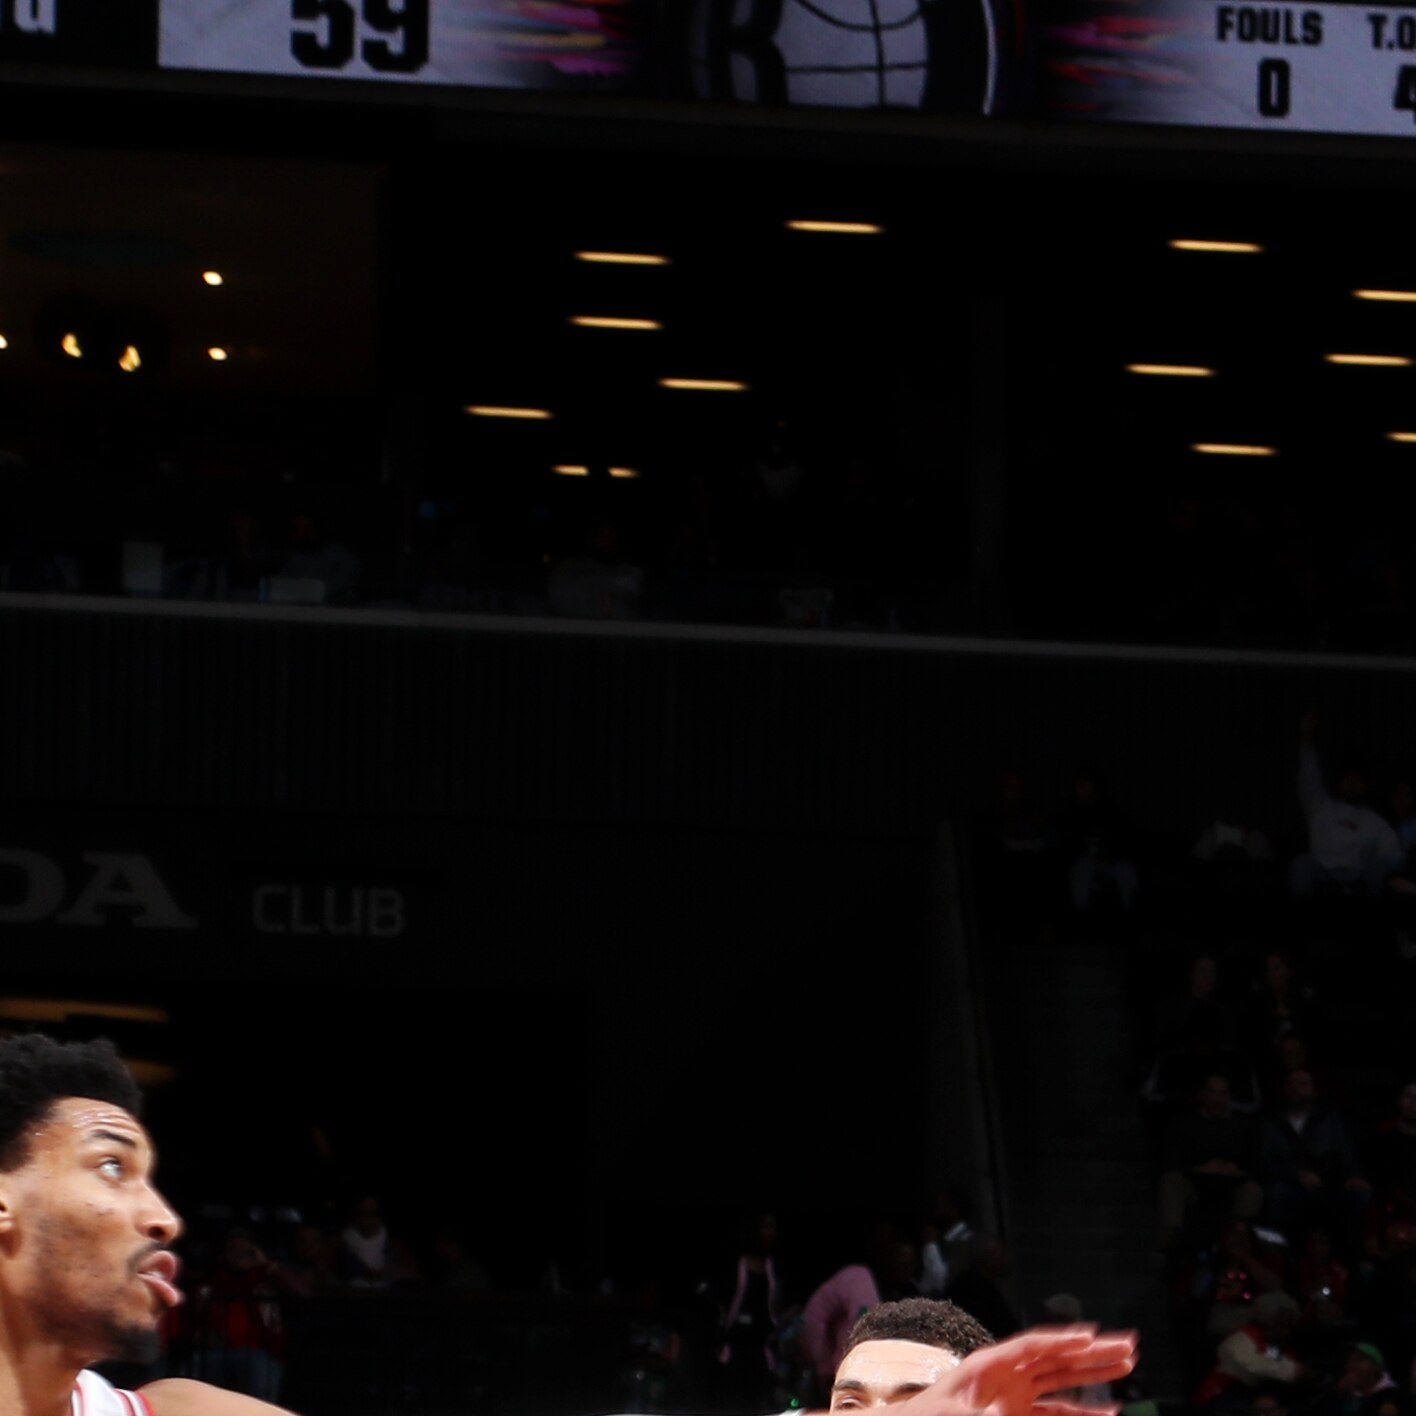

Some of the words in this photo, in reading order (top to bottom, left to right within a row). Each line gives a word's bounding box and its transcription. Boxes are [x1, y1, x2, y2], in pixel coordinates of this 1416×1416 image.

[1216, 6, 1323, 47] FOULS
[1257, 58, 1290, 118] 0
[252, 883, 408, 939] CLUB
